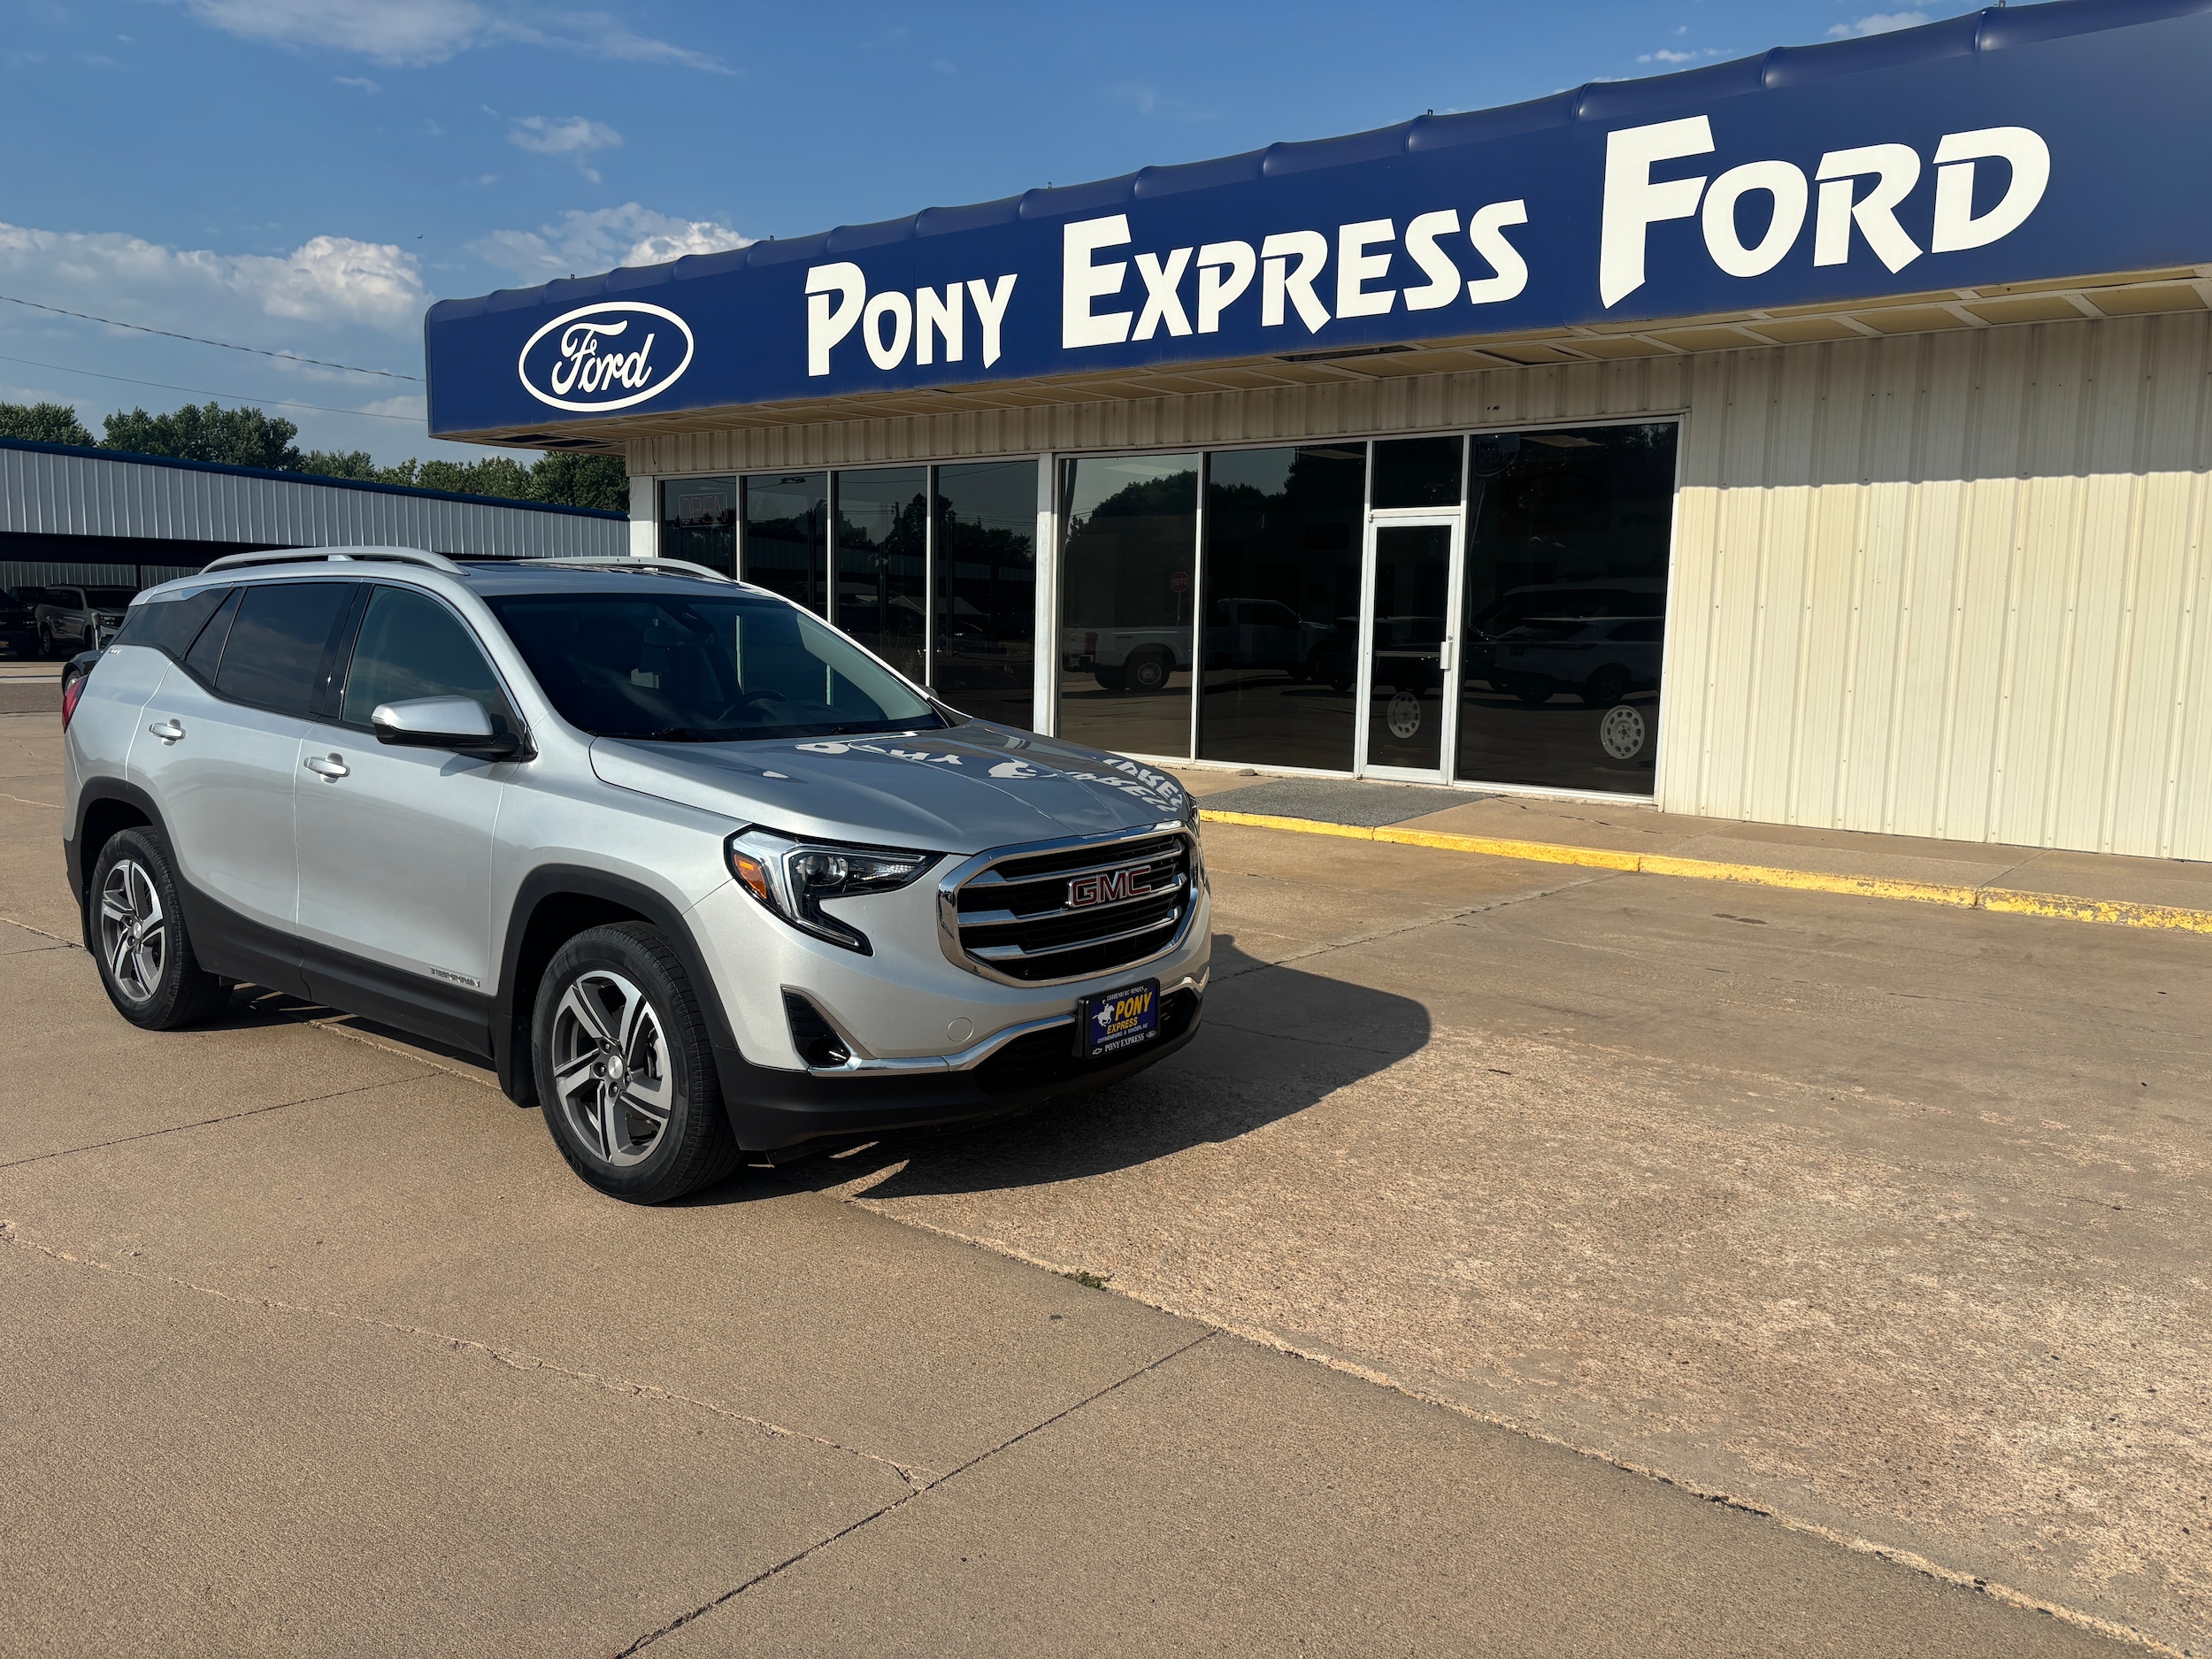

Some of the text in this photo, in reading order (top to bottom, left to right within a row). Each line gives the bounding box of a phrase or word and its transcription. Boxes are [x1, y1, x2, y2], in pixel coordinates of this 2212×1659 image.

[804, 114, 2051, 377] PONY EXPRESS FORD
[551, 320, 655, 396] Ford
[680, 495, 727, 525] OPEN
[1067, 864, 1152, 908] GMC
[1115, 992, 1153, 1021] PONY
[1107, 1017, 1138, 1034] EXPRESS
[1104, 1041, 1121, 1052] PONY
[1120, 1033, 1145, 1048] EXPRESS
